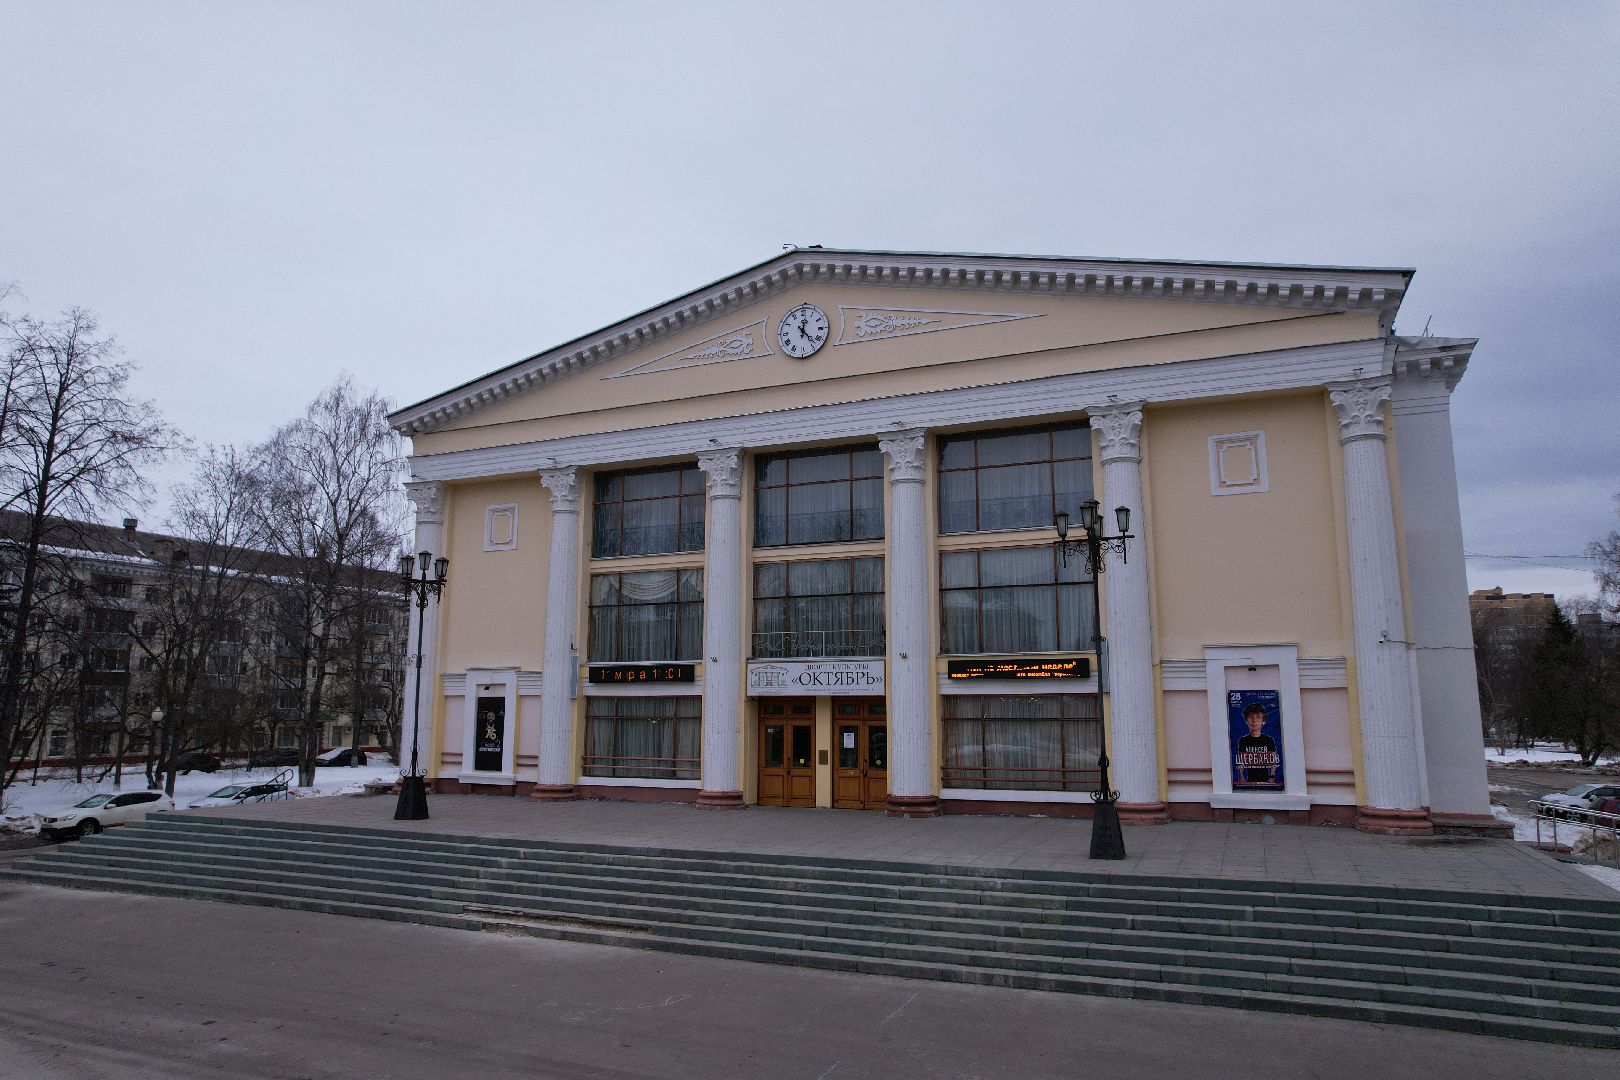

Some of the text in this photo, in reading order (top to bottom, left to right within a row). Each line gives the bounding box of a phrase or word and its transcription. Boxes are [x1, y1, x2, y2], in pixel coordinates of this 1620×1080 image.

[792, 671, 883, 686] «ОКТЯБРЬ»
[1230, 693, 1241, 701] 28
[1235, 753, 1280, 766] ЩЕРБАКОВ
